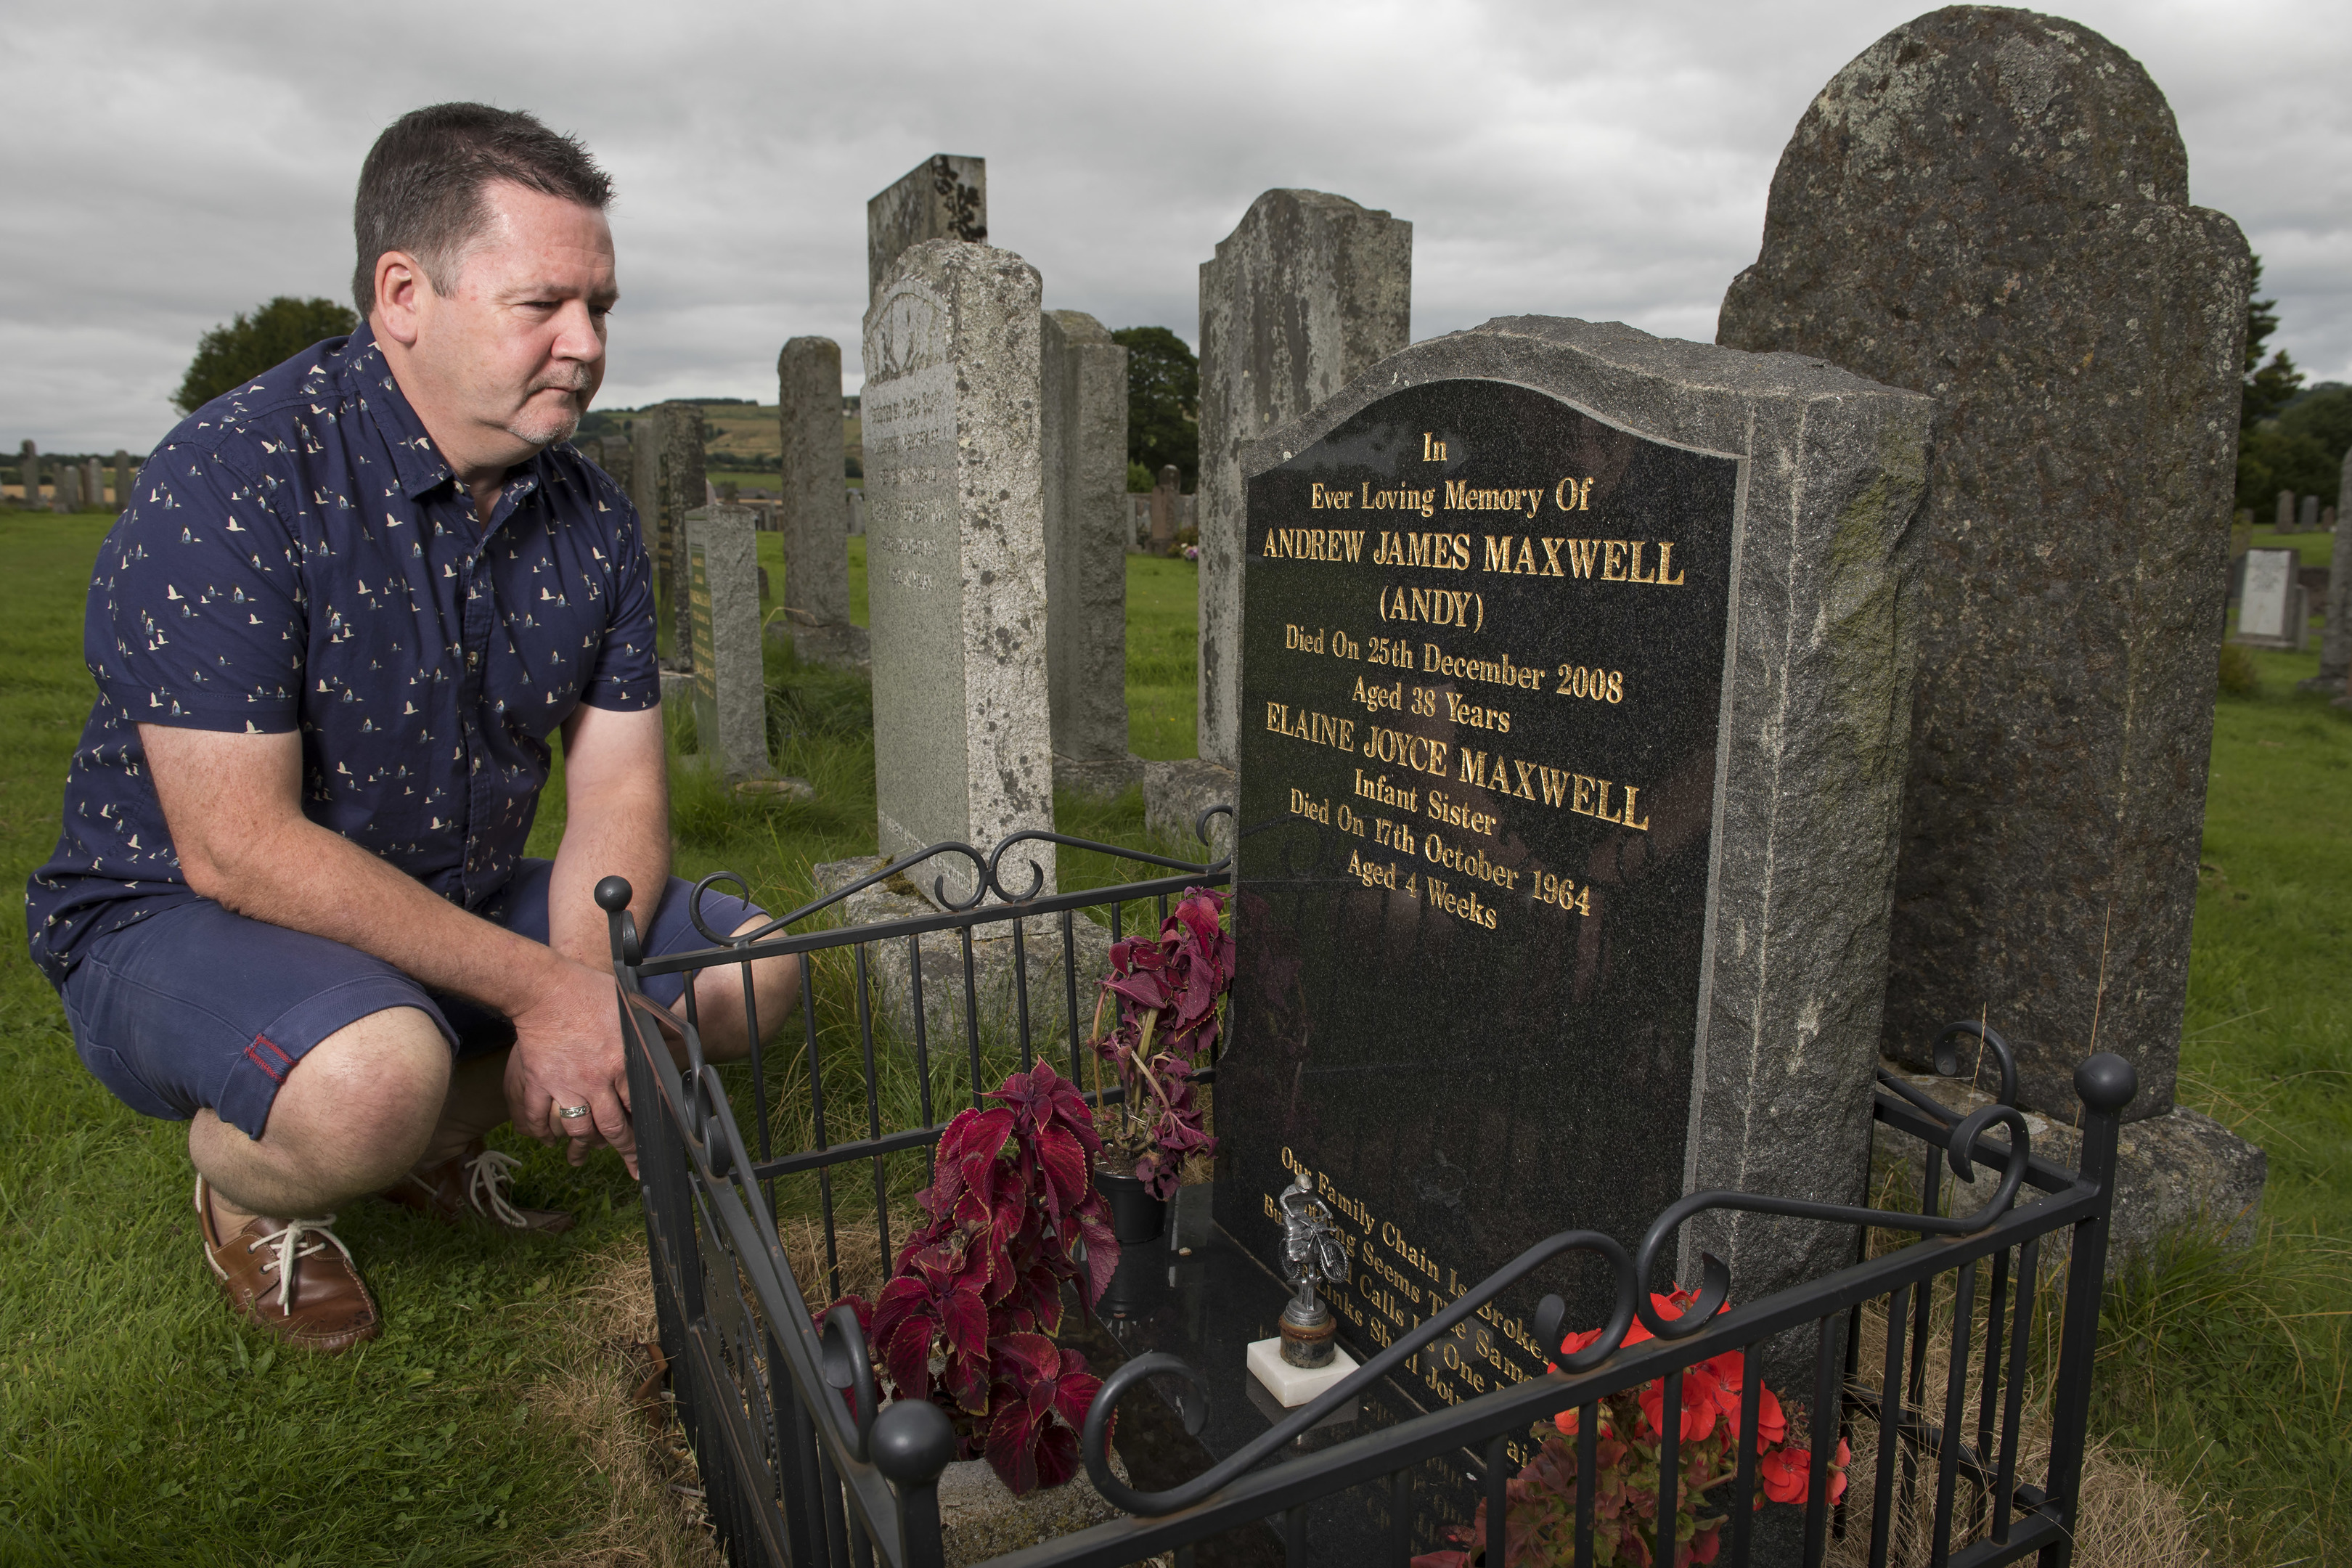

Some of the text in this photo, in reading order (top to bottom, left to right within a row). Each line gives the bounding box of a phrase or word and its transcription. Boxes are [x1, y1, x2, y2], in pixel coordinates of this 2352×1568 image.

[1423, 432, 1447, 461] In
[1311, 477, 1594, 518] Ever Loving Memory Of
[1263, 528, 1684, 585] ANDREW JAMES MAXWELL
[1381, 587, 1483, 633] (ANDY)
[1286, 624, 1623, 703] Died On 25th December 2008
[1352, 675, 1510, 732] Aged 38 Years
[1267, 701, 1649, 832] ELAINE JOYCE MAXWELL
[1355, 767, 1497, 838] Infant Sister
[1291, 788, 1591, 916] Died On 17th October 1964
[1348, 846, 1498, 929] Aged 4 Weeks
[1318, 1172, 1375, 1236] Family
[1382, 1222, 1439, 1284] Chain
[1477, 1301, 1549, 1368] Broke
[1363, 1241, 1422, 1305] Seems
[1429, 1287, 1467, 1339] Te
[1360, 1274, 1487, 1390] Calls One
